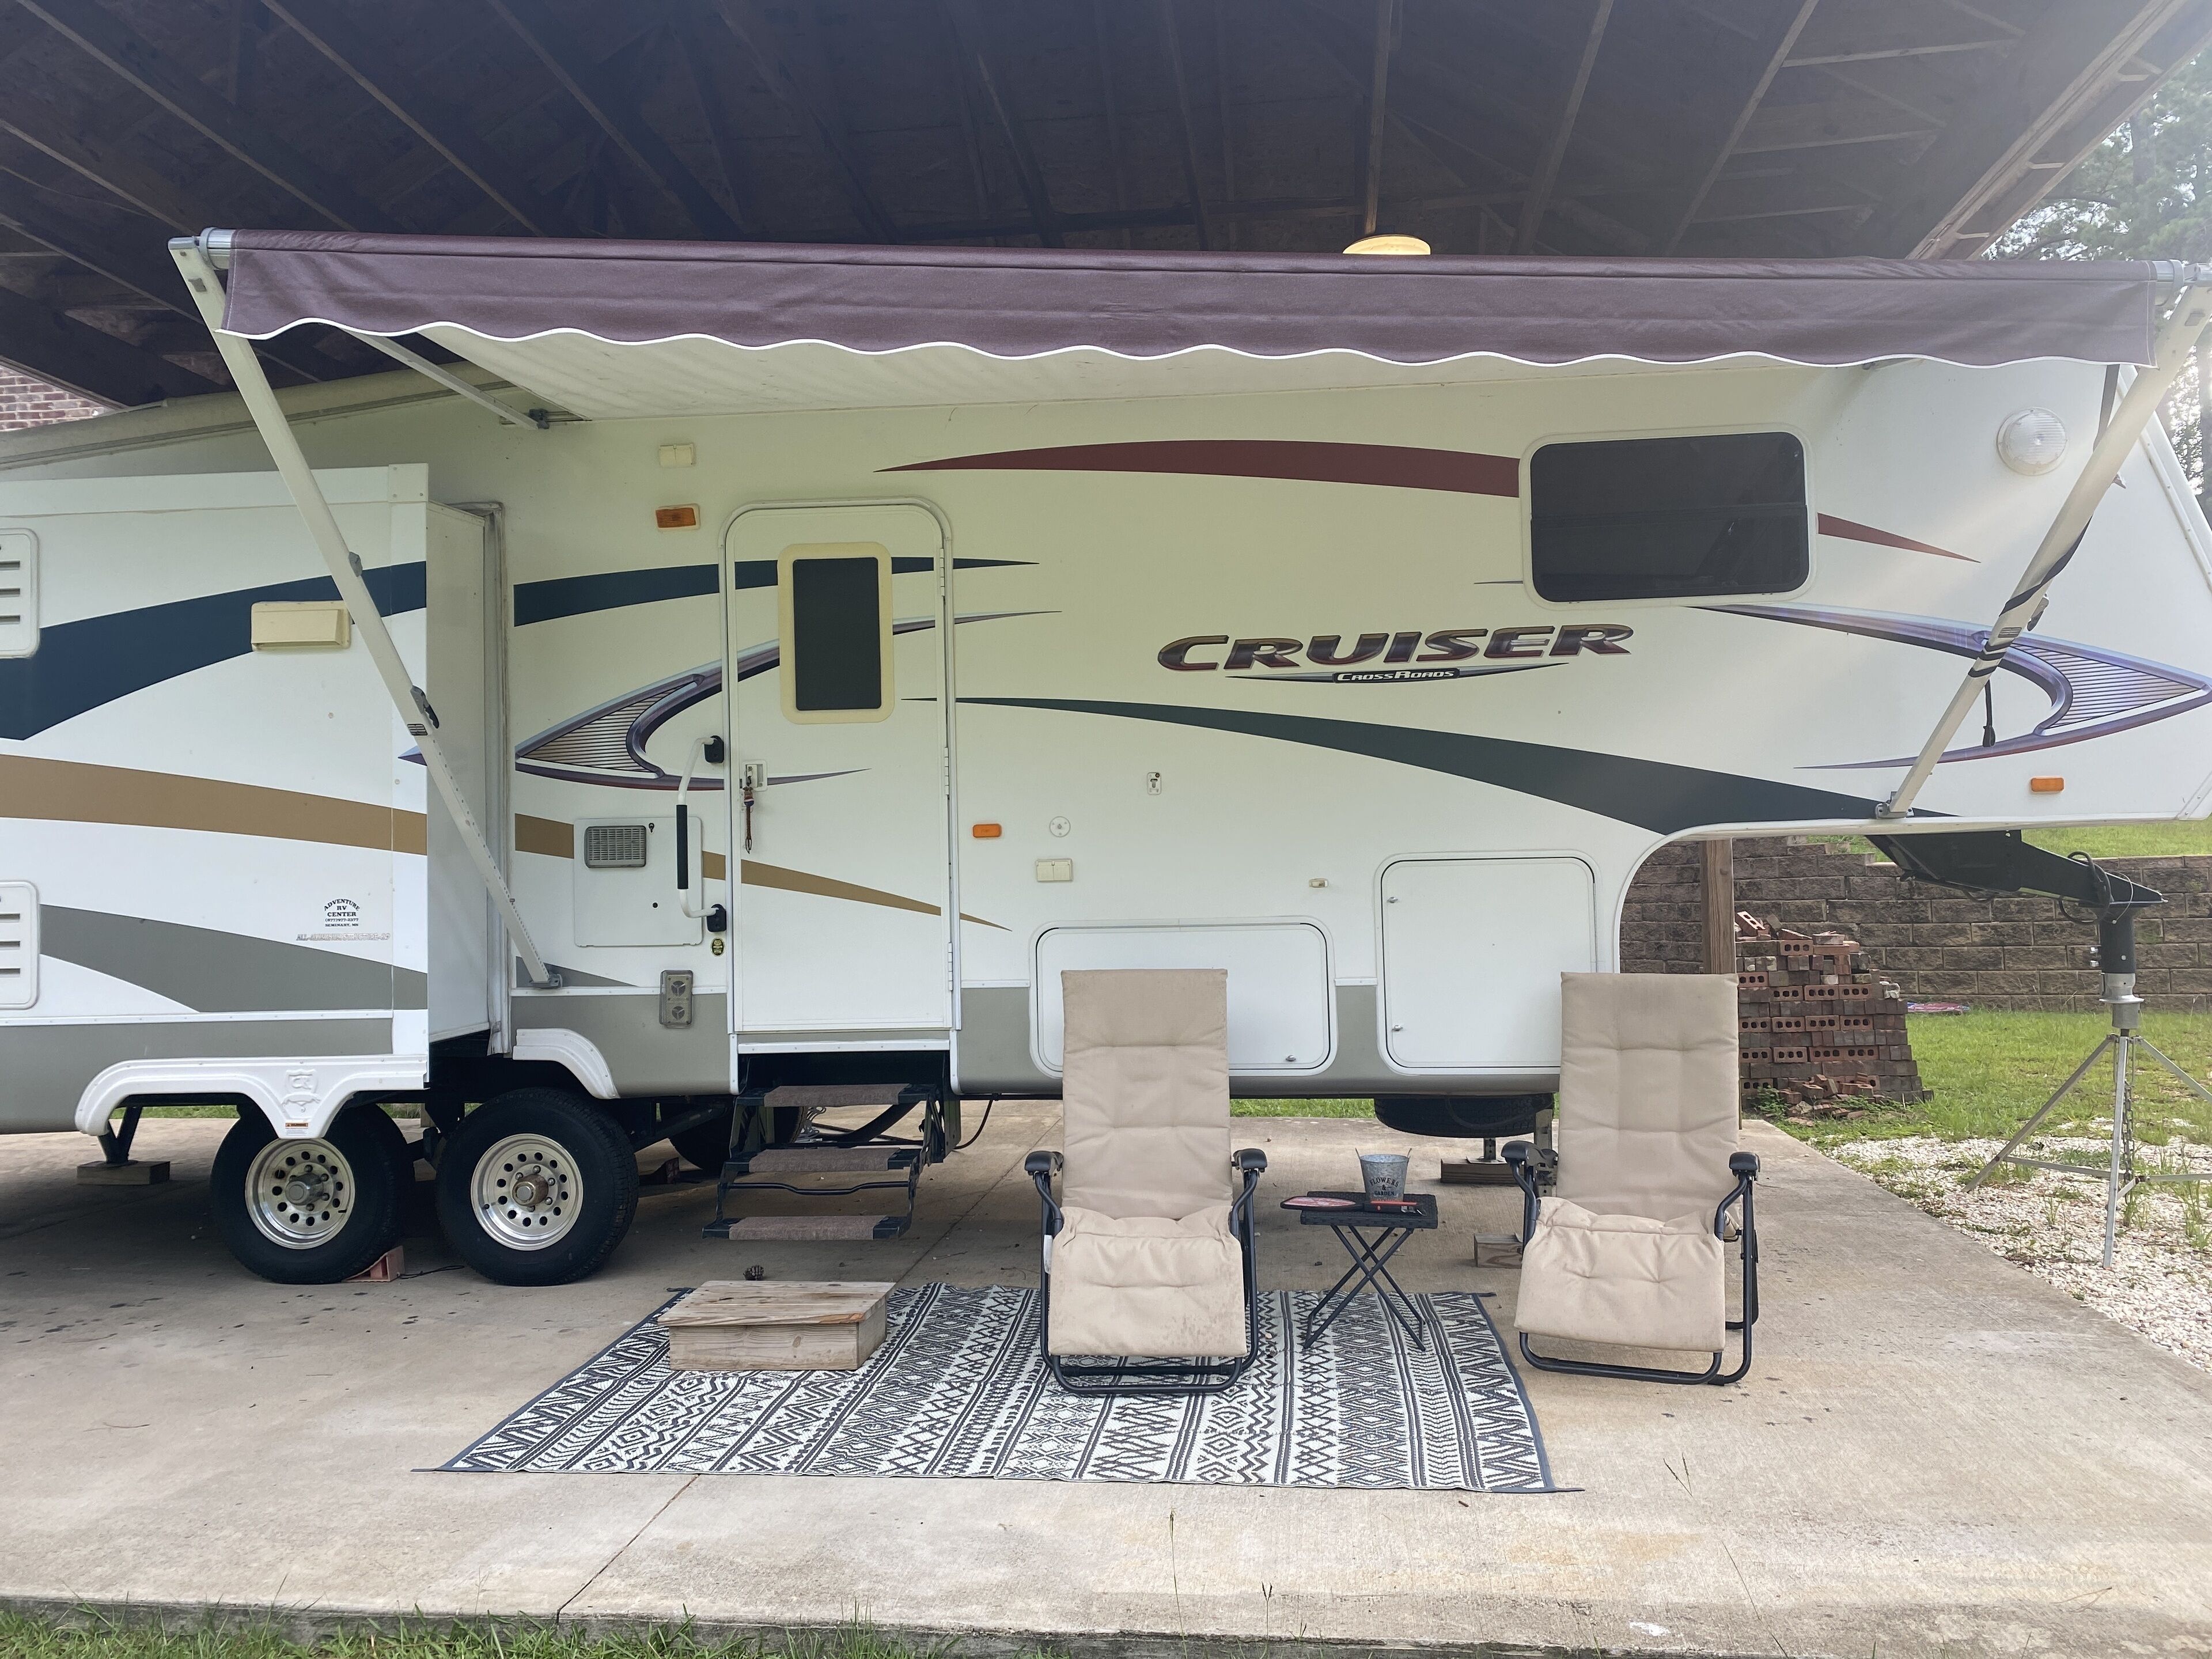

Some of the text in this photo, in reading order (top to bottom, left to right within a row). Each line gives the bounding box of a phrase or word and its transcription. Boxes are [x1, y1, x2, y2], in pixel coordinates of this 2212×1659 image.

[1157, 623, 1634, 671] CRUISER
[324, 899, 359, 911] ADVENTURE
[1369, 1177, 1399, 1188] FLOWERS
